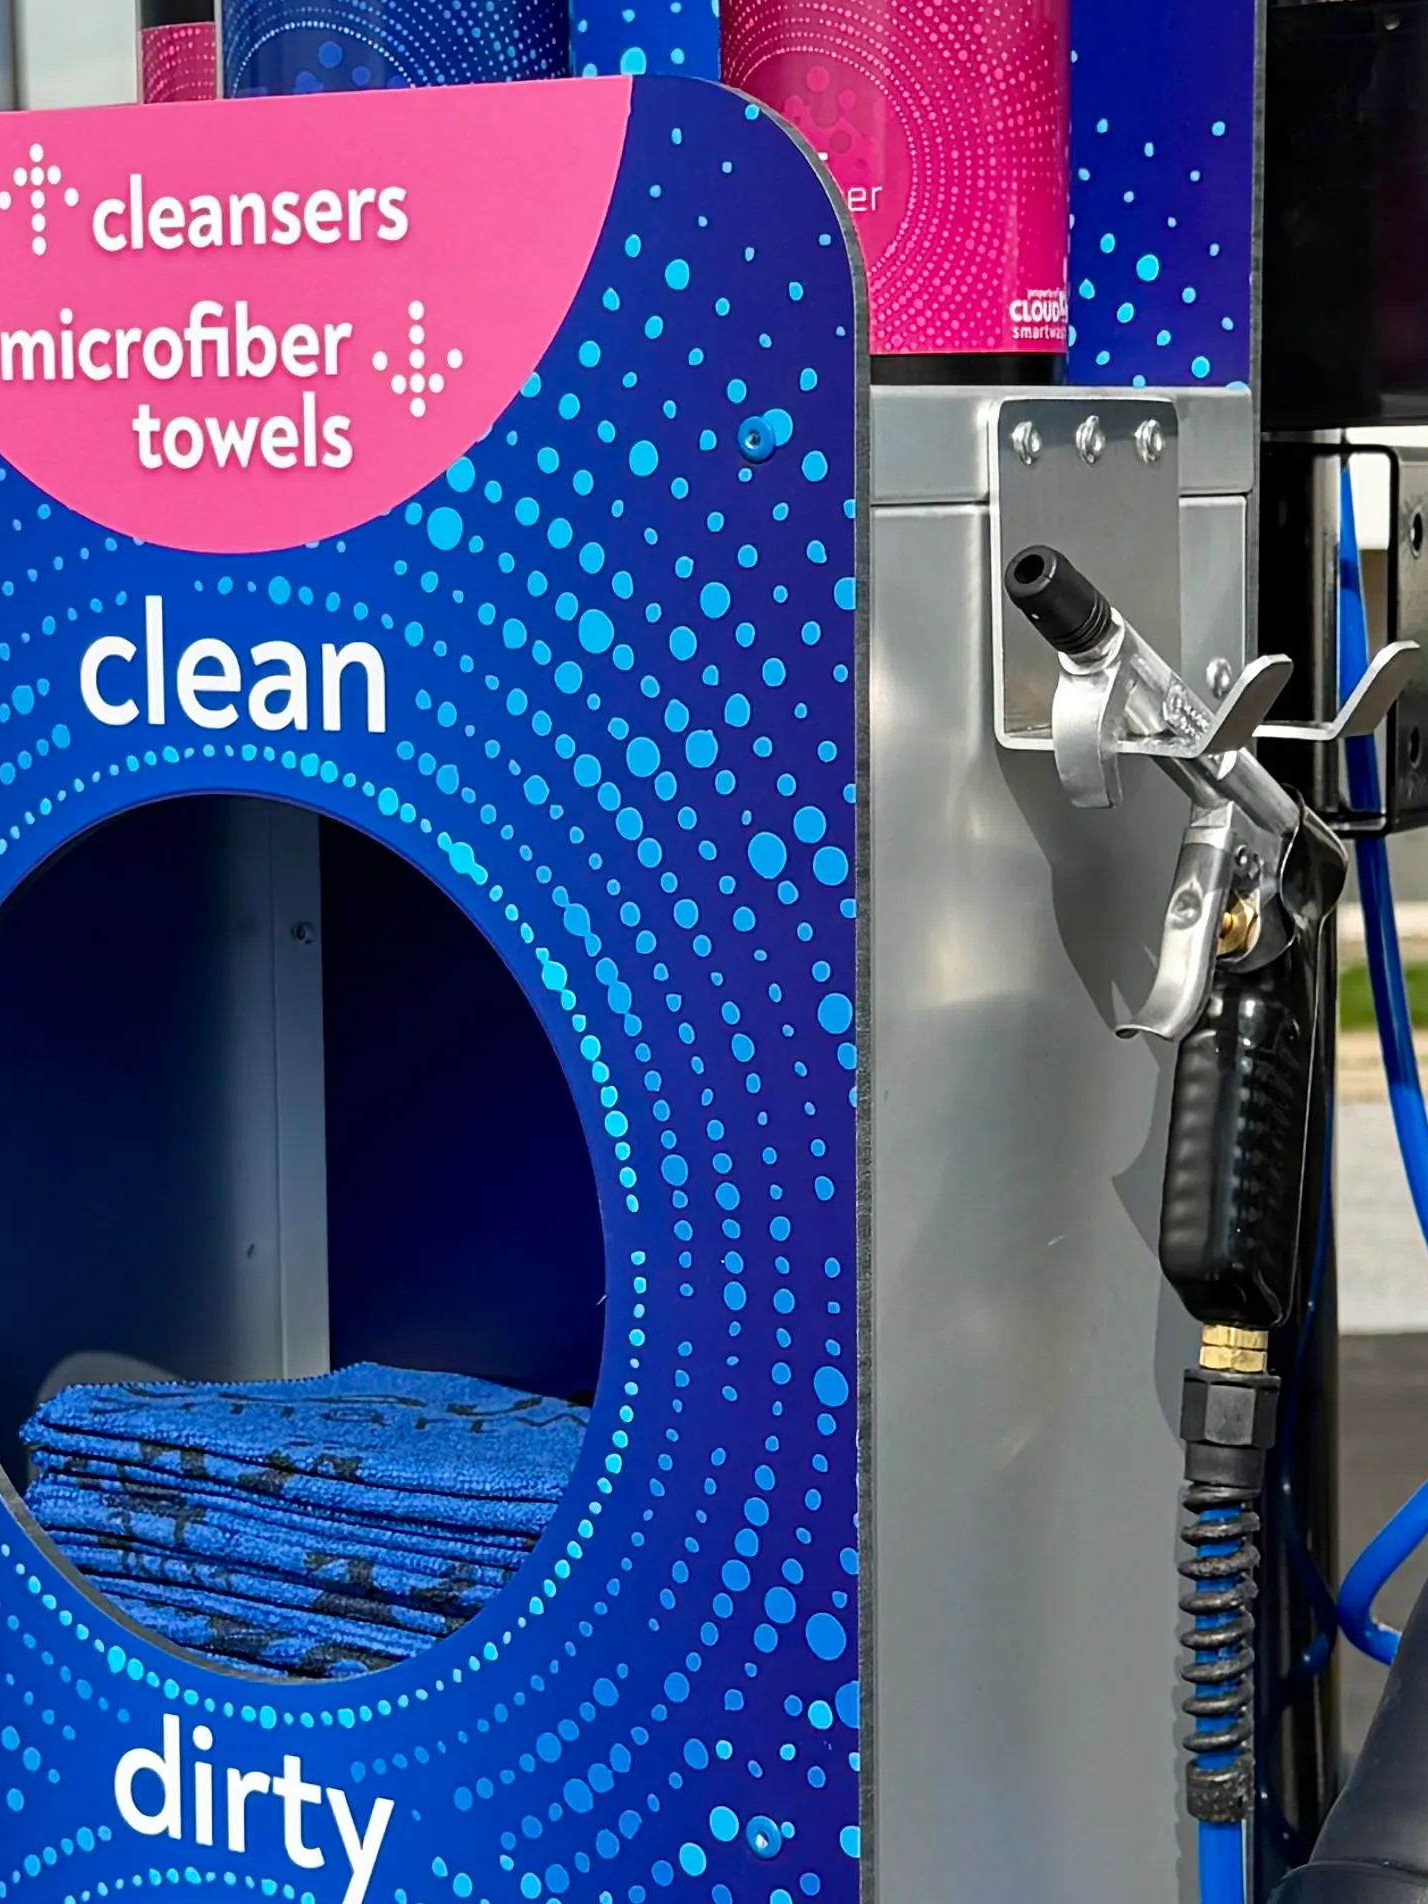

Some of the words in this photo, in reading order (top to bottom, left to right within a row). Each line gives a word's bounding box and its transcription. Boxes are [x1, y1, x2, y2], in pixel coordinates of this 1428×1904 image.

[92, 173, 409, 251] cleansers
[0, 300, 353, 381] microfiber
[132, 392, 354, 470] towels
[80, 595, 386, 733] clean
